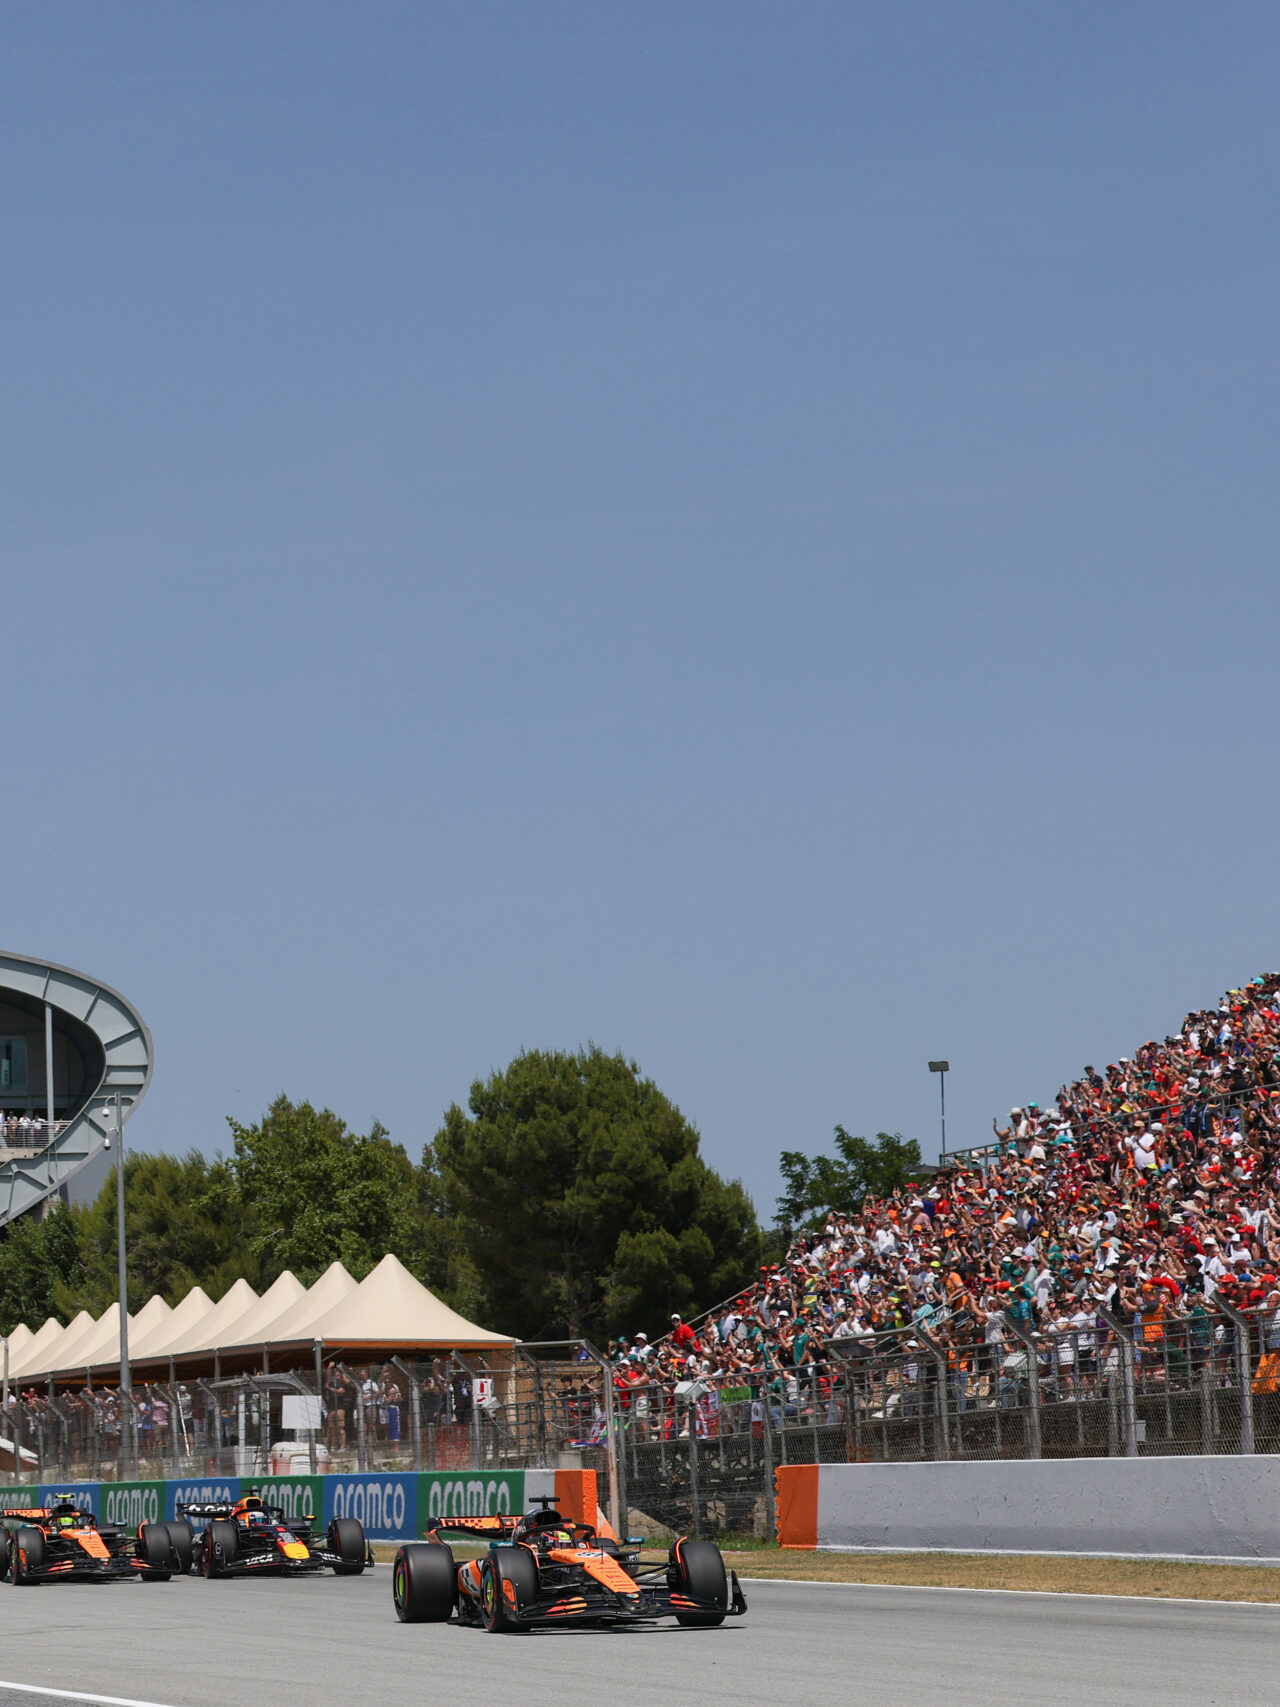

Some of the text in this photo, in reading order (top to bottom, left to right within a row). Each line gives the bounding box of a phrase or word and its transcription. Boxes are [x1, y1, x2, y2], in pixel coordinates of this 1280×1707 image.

[107, 1488, 158, 1528] aramco
[252, 1484, 314, 1526] ramco
[333, 1482, 405, 1530] aramco
[429, 1480, 511, 1518] aramco
